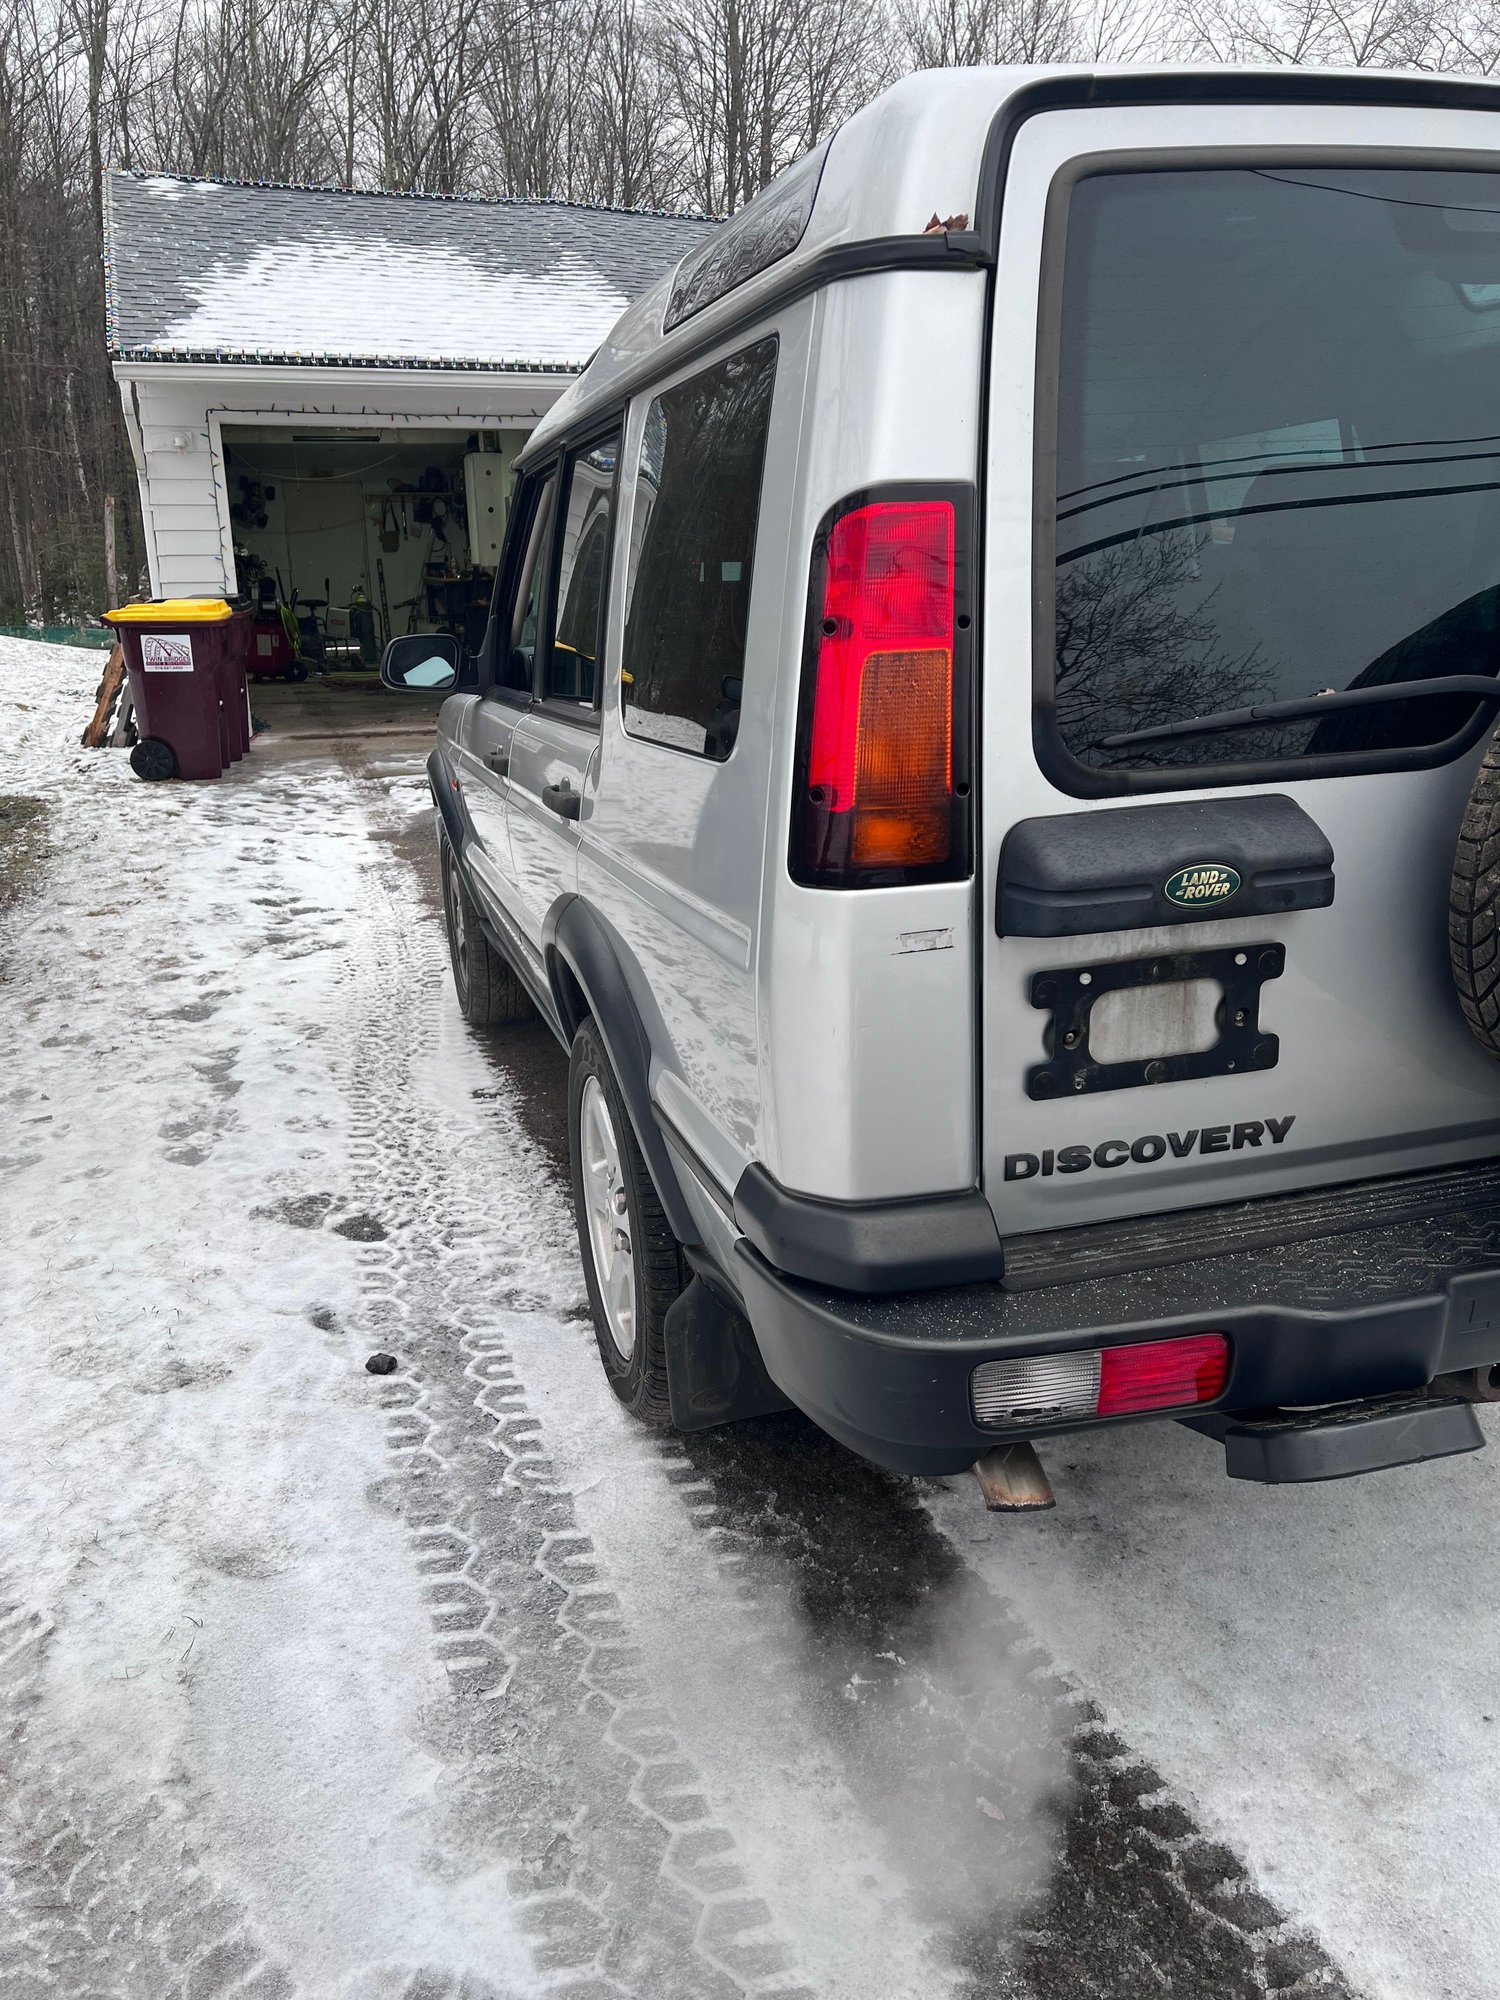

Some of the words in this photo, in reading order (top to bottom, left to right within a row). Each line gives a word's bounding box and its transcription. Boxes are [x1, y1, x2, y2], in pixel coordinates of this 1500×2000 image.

[1181, 870, 1220, 887] LAND
[1183, 882, 1231, 899] ROVER
[1004, 1115, 1297, 1182] DISCOVERY
